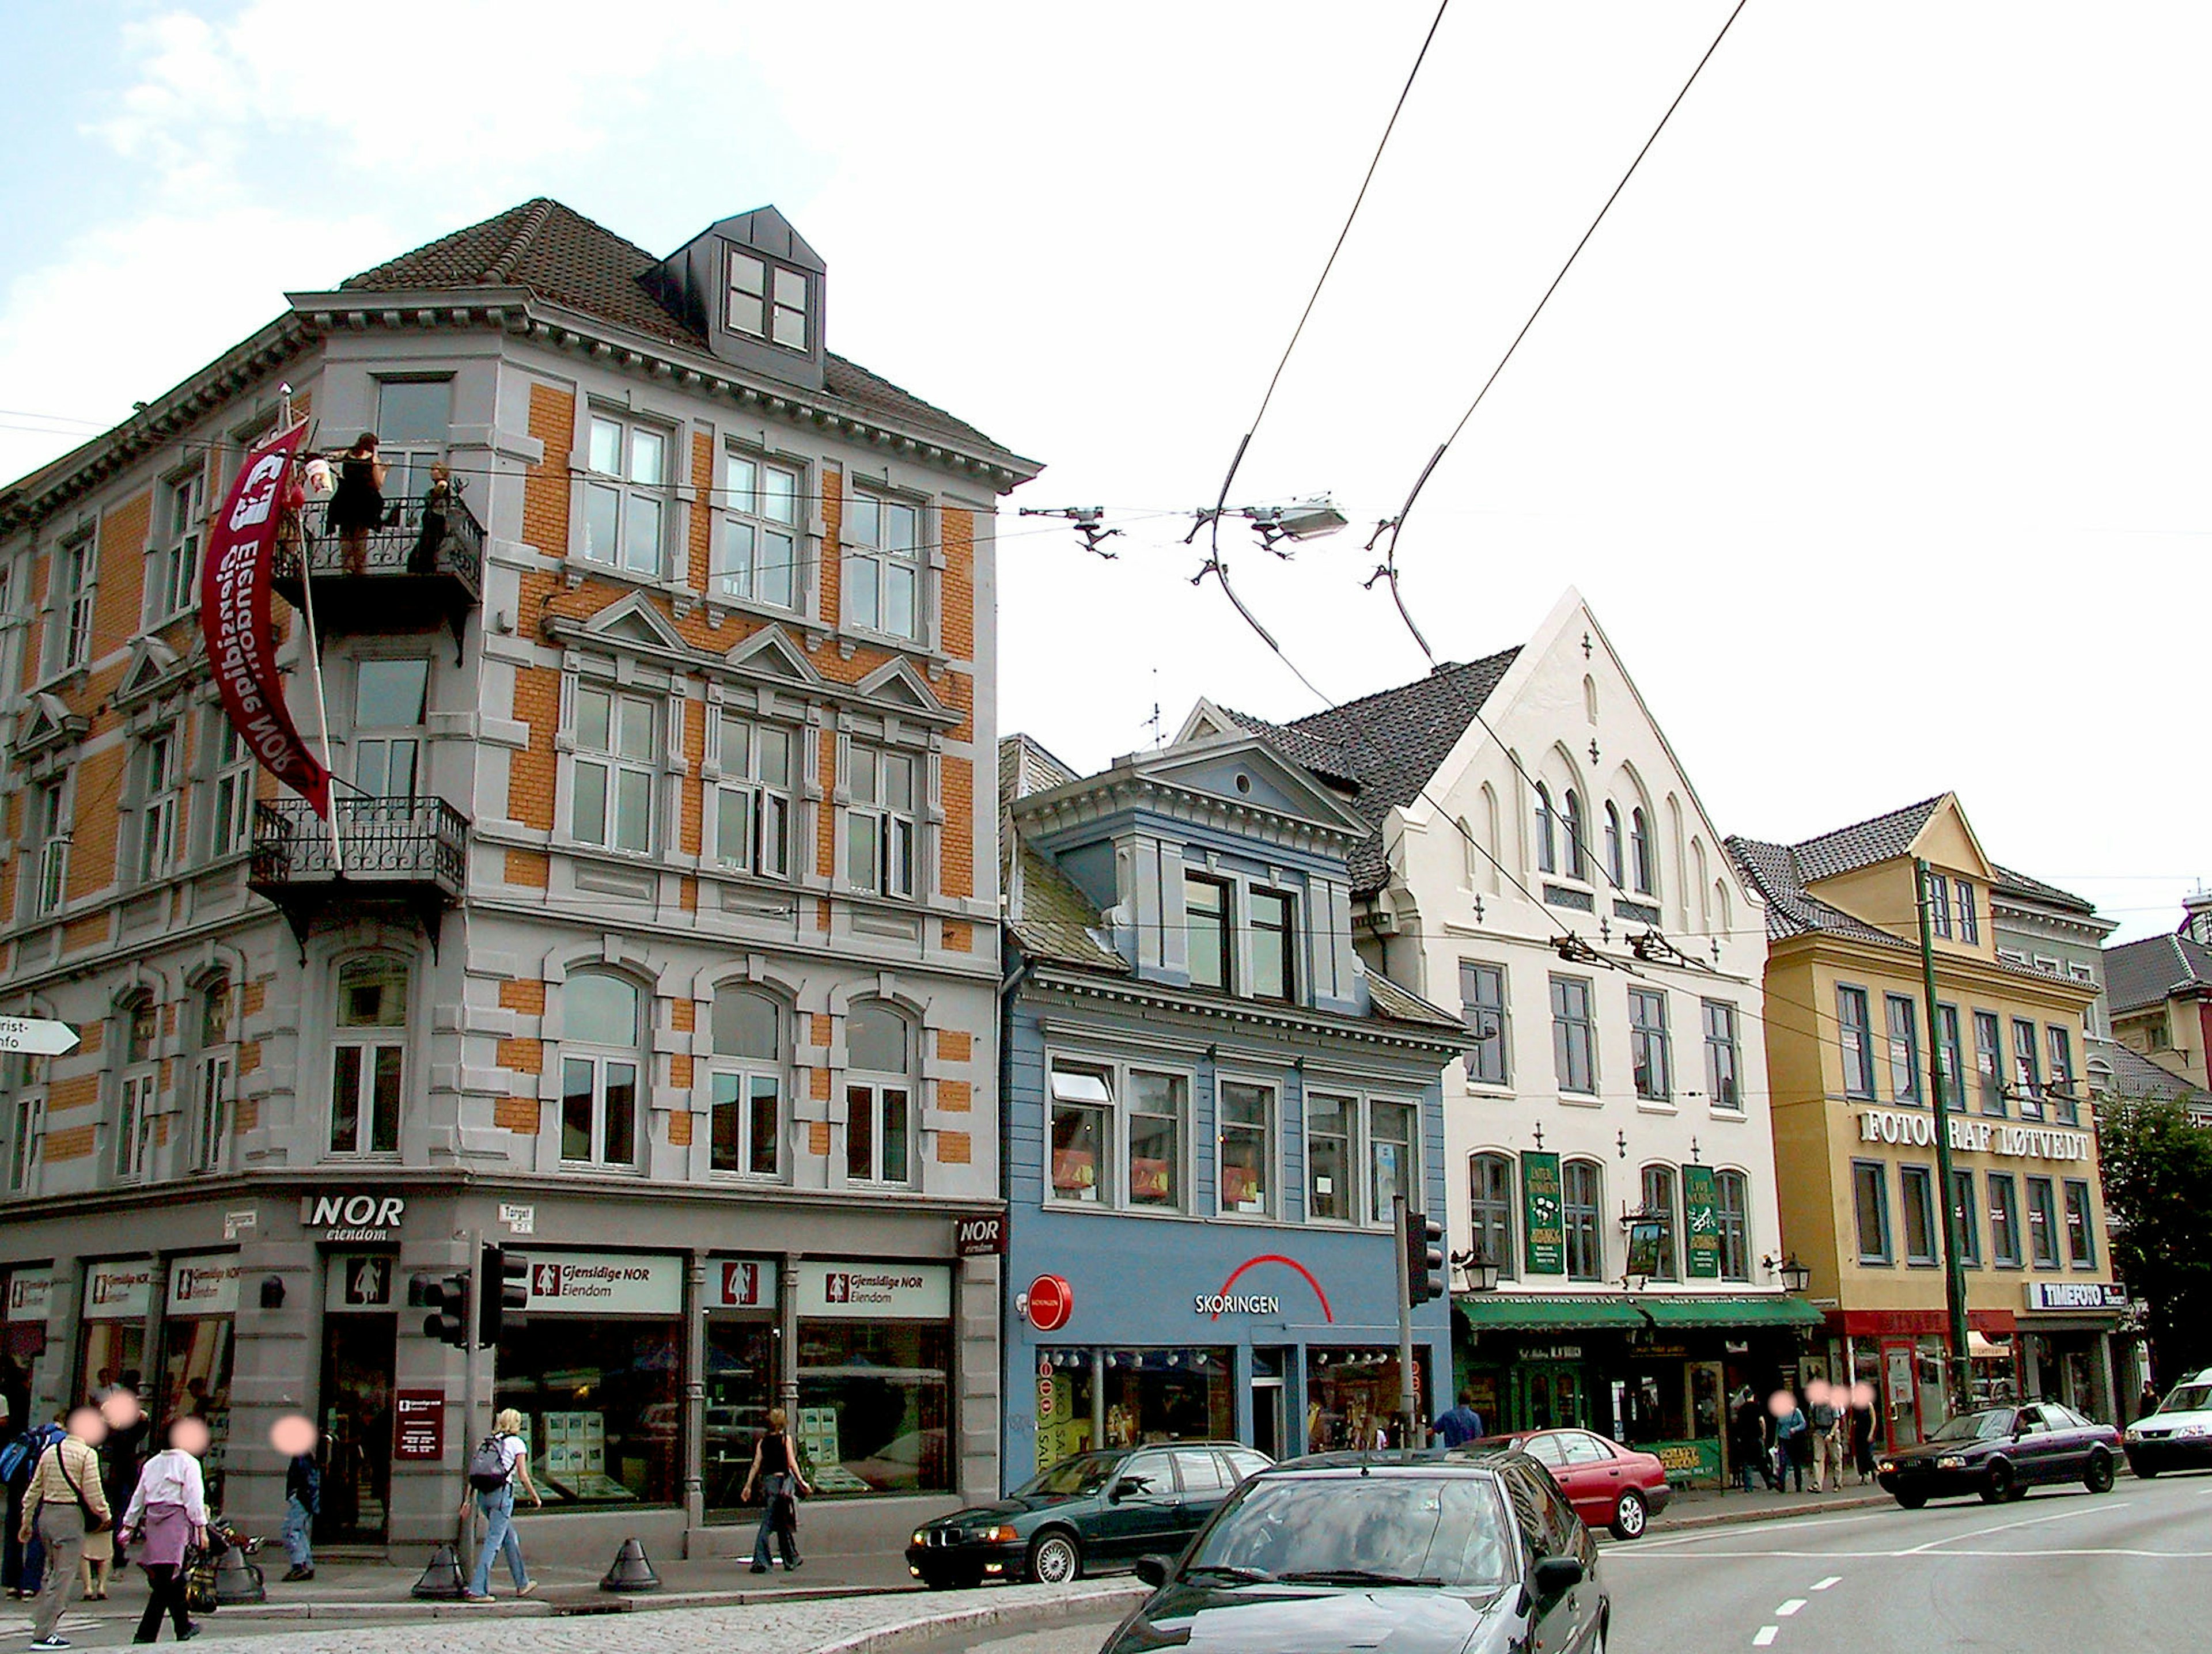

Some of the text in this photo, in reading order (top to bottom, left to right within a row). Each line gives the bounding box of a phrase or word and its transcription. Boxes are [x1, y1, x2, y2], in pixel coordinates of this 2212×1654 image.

[1996, 1125, 2089, 1160] LØTVEDT
[312, 1195, 405, 1226] NOR
[326, 1226, 387, 1240] eiendom
[960, 1220, 999, 1241] NOR
[562, 1265, 650, 1282] Gjensidige NOR
[851, 1274, 923, 1289] Gjensidige NOR
[562, 1283, 612, 1297] Eiendom
[850, 1291, 892, 1303] Eiendom
[2044, 1284, 2102, 1306] TIMEFOTO
[1195, 1295, 1279, 1314] SKORINGEN
